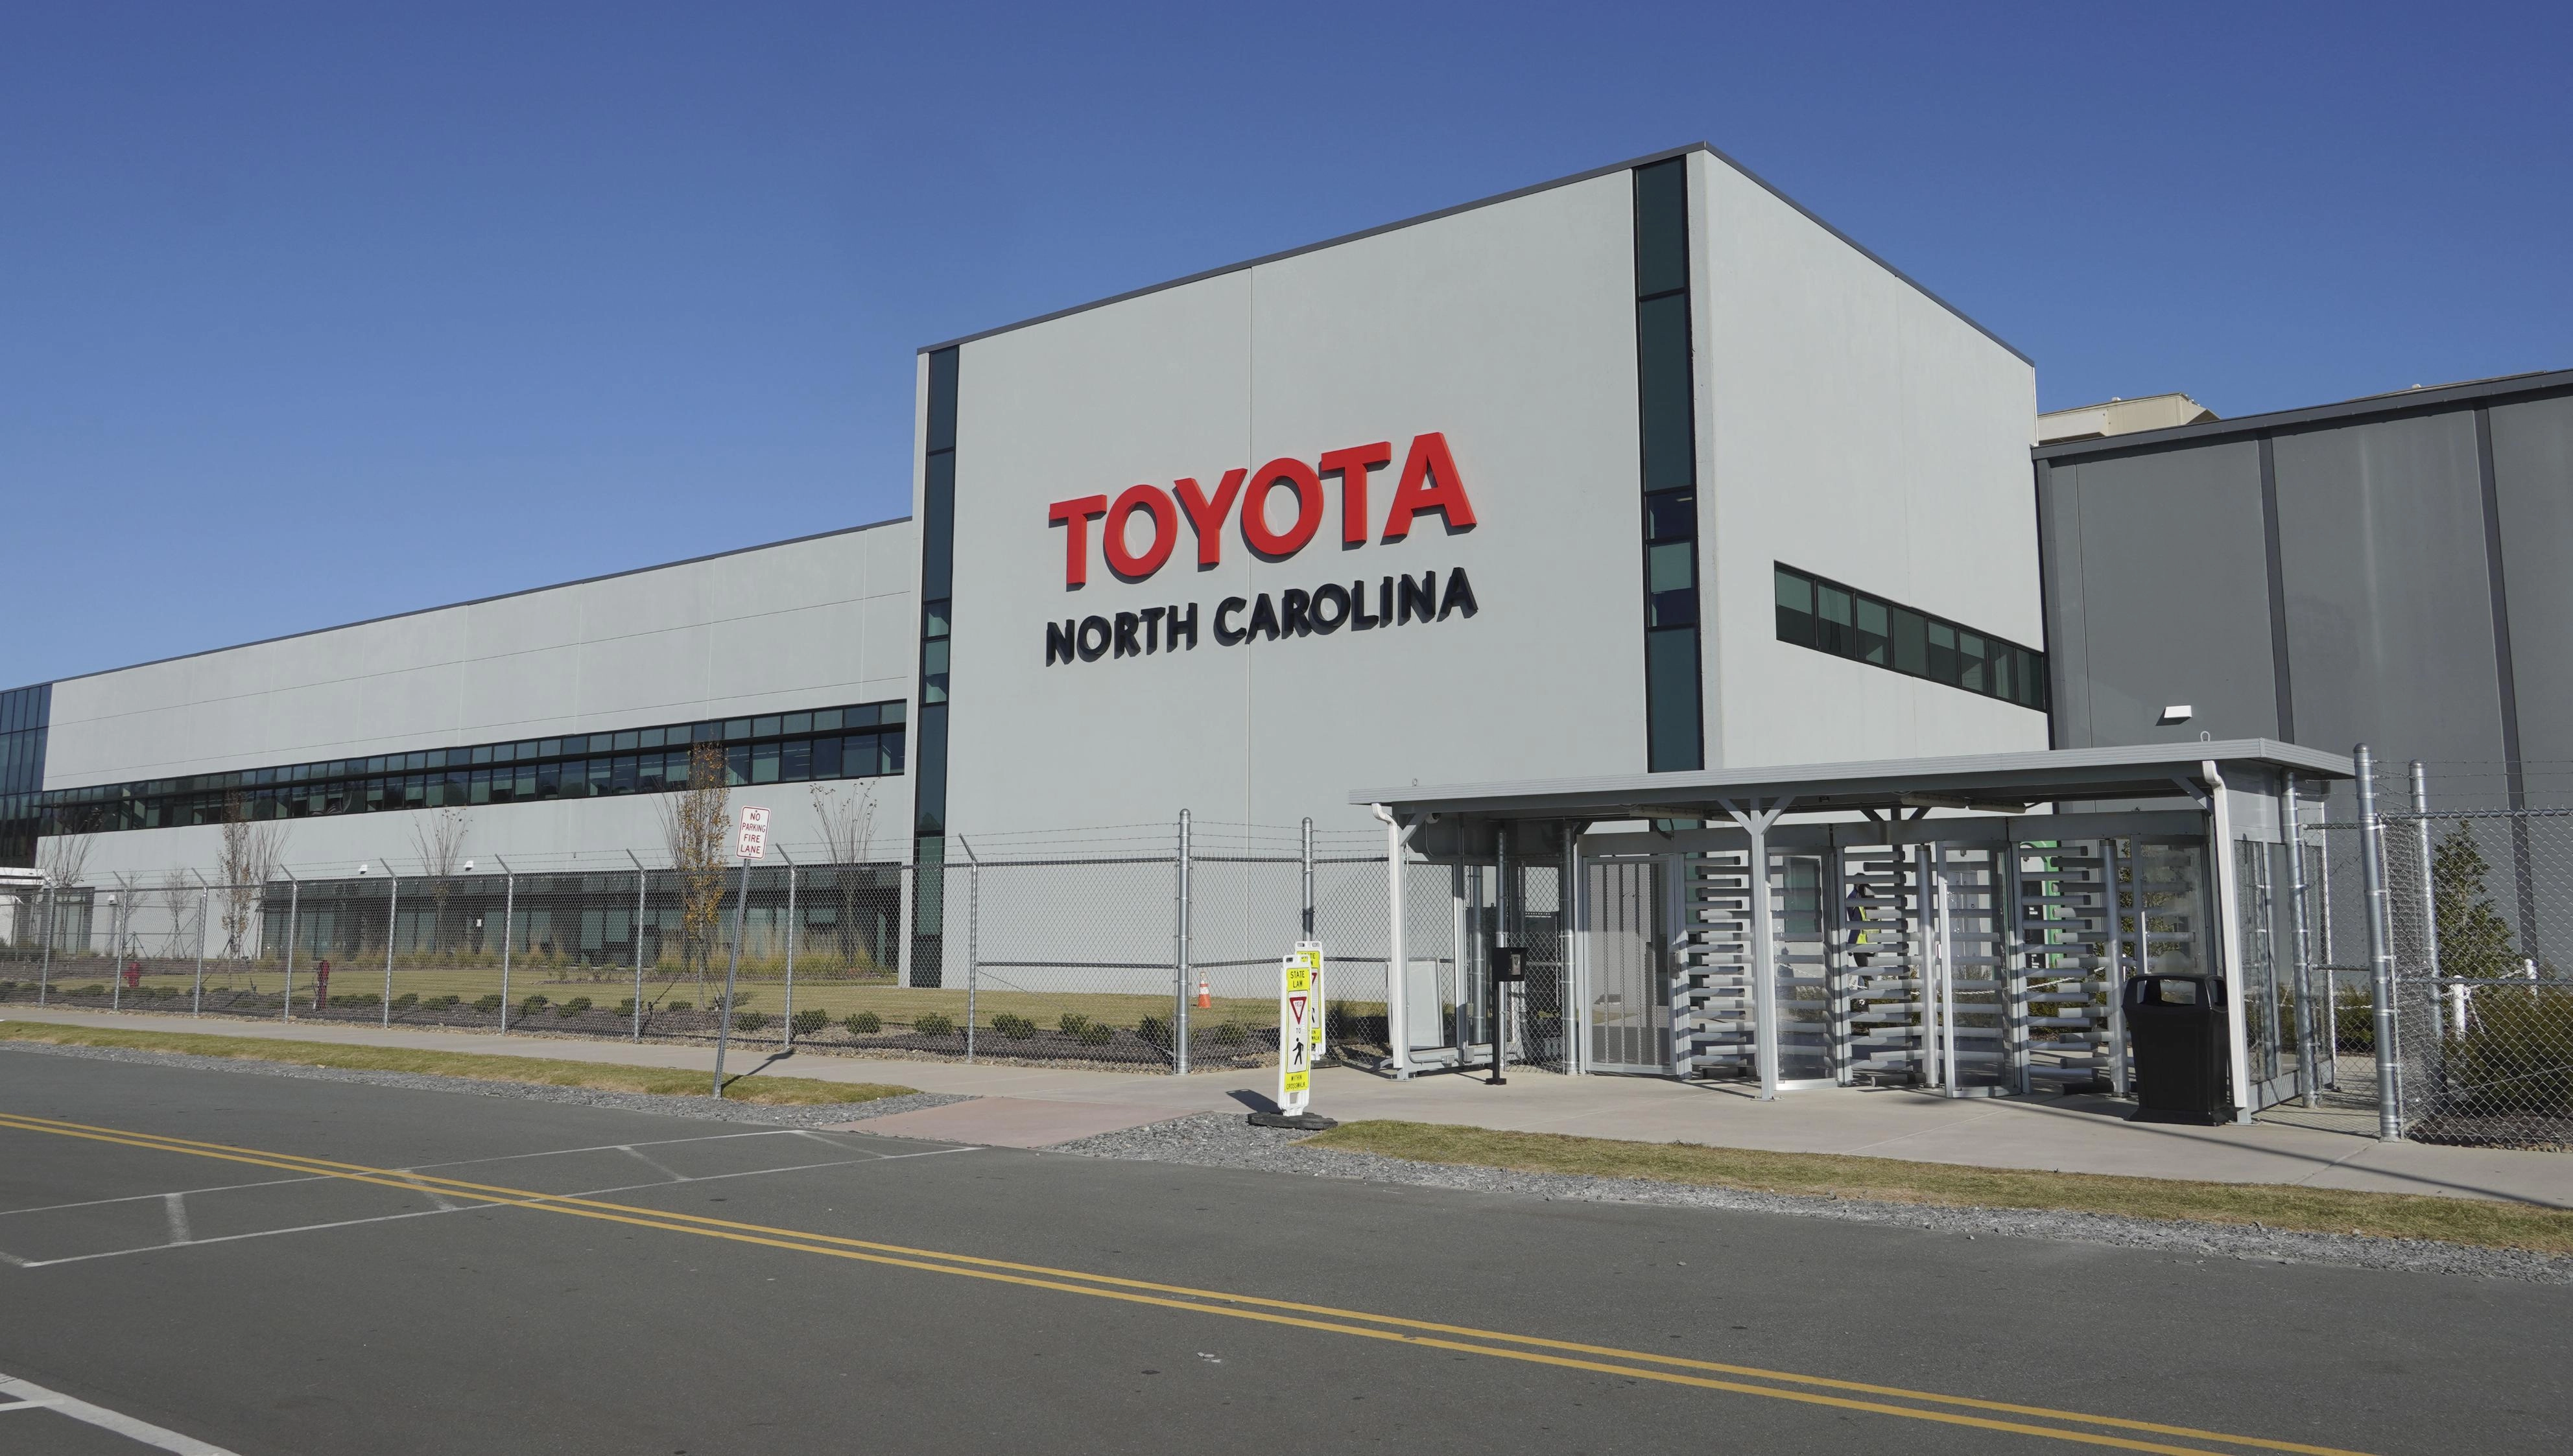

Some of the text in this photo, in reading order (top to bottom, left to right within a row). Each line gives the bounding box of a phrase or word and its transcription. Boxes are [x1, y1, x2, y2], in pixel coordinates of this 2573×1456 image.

[1049, 432, 1476, 590] TOYOTA
[1046, 568, 1478, 667] NORTH CAROLINA
[750, 813, 761, 821] NO
[742, 823, 766, 833] PARKING
[744, 834, 761, 843] FIRE
[741, 844, 761, 854] LANE
[1290, 970, 1305, 979] STATE
